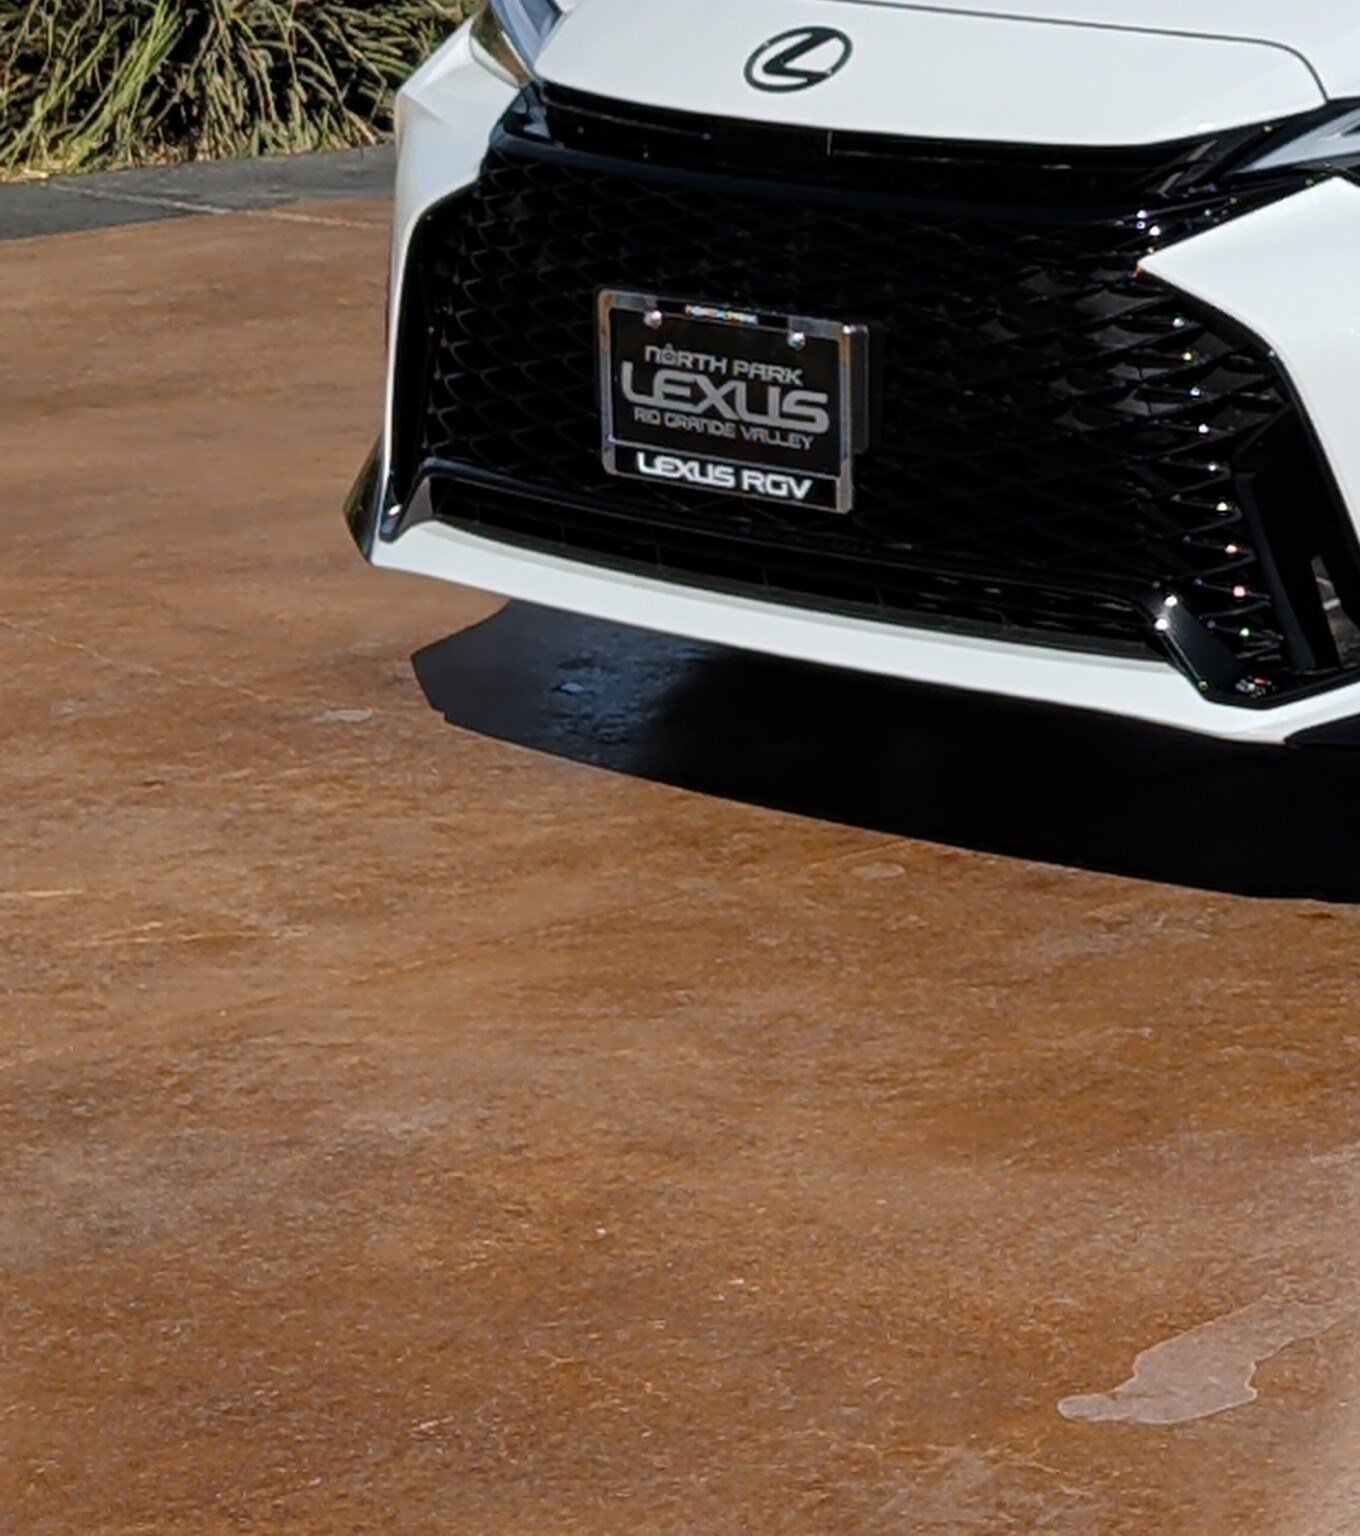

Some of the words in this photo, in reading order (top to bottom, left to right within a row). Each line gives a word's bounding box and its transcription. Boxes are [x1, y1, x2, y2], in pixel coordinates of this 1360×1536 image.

[732, 359, 804, 386] PARK
[620, 360, 831, 434] LEXUS
[633, 406, 661, 425] RIO
[664, 412, 737, 438] GRANDE
[740, 424, 815, 451] VALLEY
[637, 451, 736, 488] LEXUS
[742, 471, 813, 500] RGV
